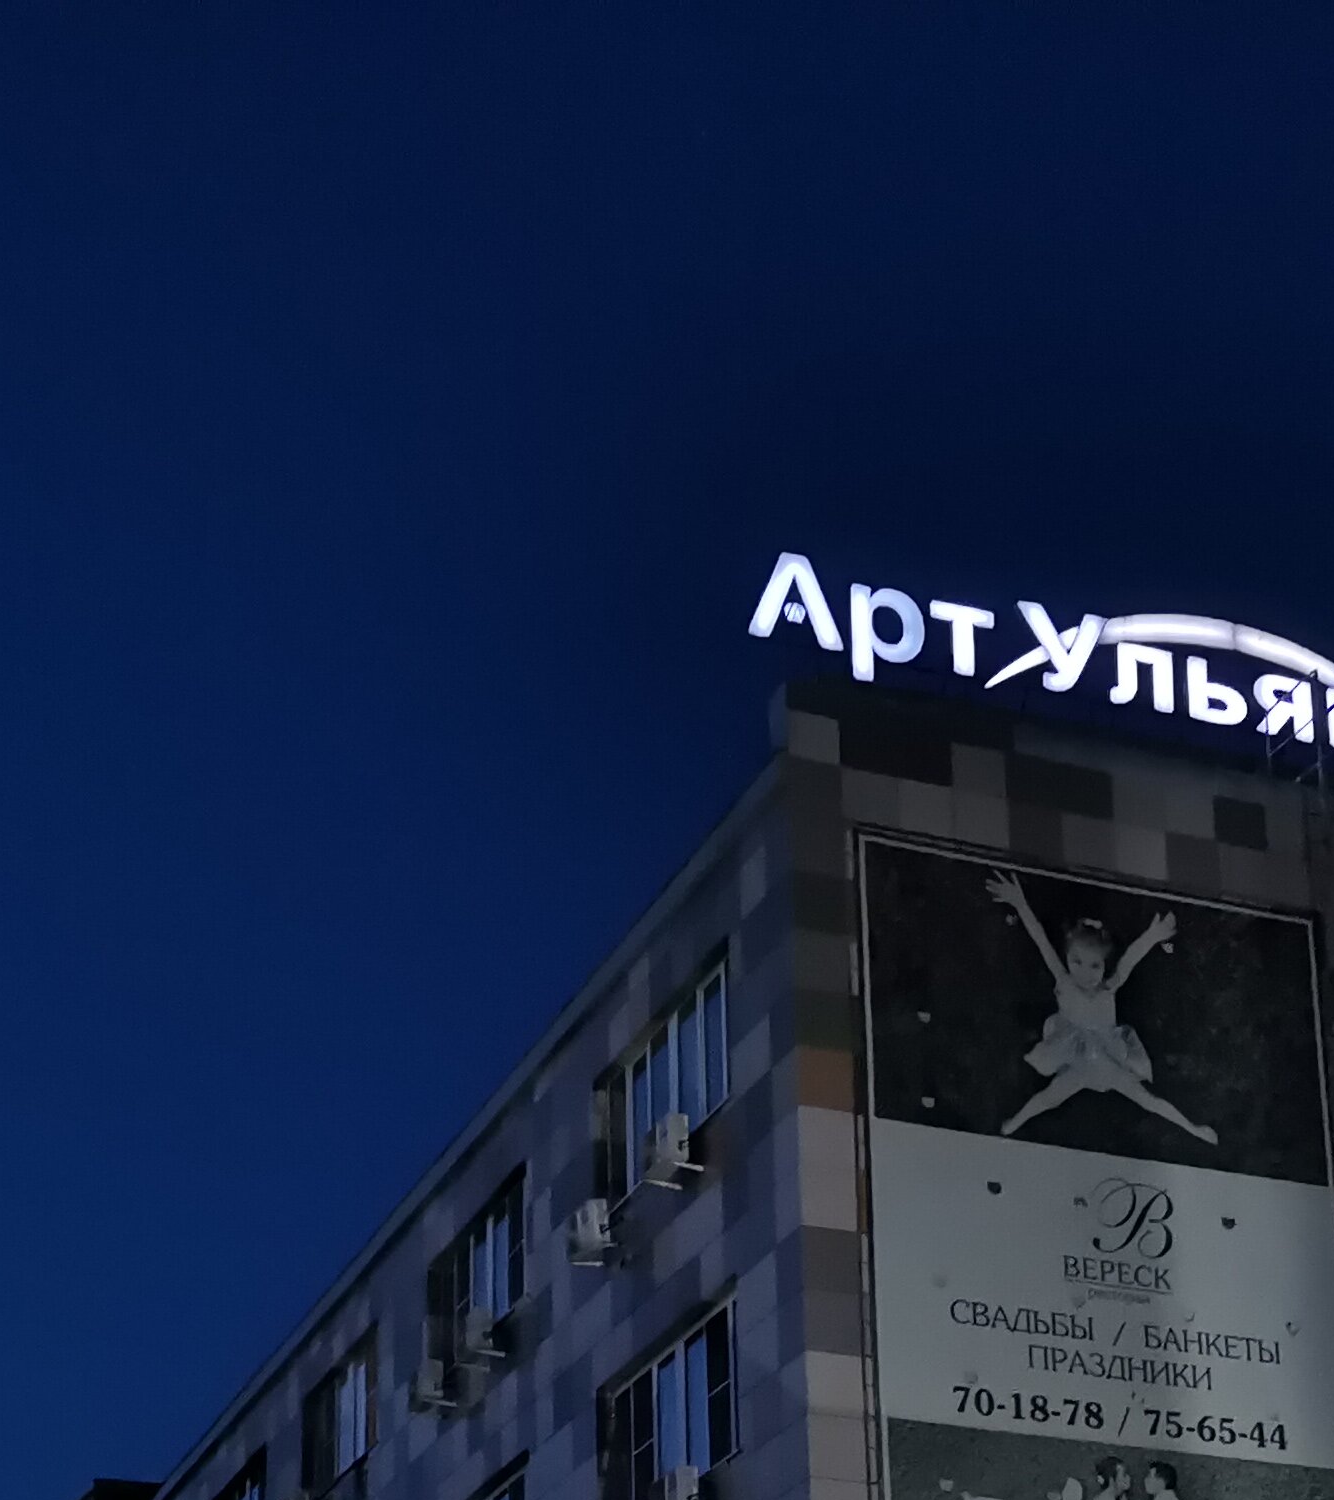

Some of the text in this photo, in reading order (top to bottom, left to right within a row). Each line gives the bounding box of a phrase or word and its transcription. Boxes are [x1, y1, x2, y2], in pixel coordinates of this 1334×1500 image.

[1063, 1254, 1172, 1291] ВЕРЕСК
[950, 1298, 1094, 1342] СВАДЬБЫ
[1143, 1324, 1282, 1366] БАНКЕТЫ
[1027, 1344, 1213, 1391] ПРАЗДНИКИ
[952, 1385, 1105, 1431] 70-18-78
[1143, 1408, 1288, 1451] 75-65-44
